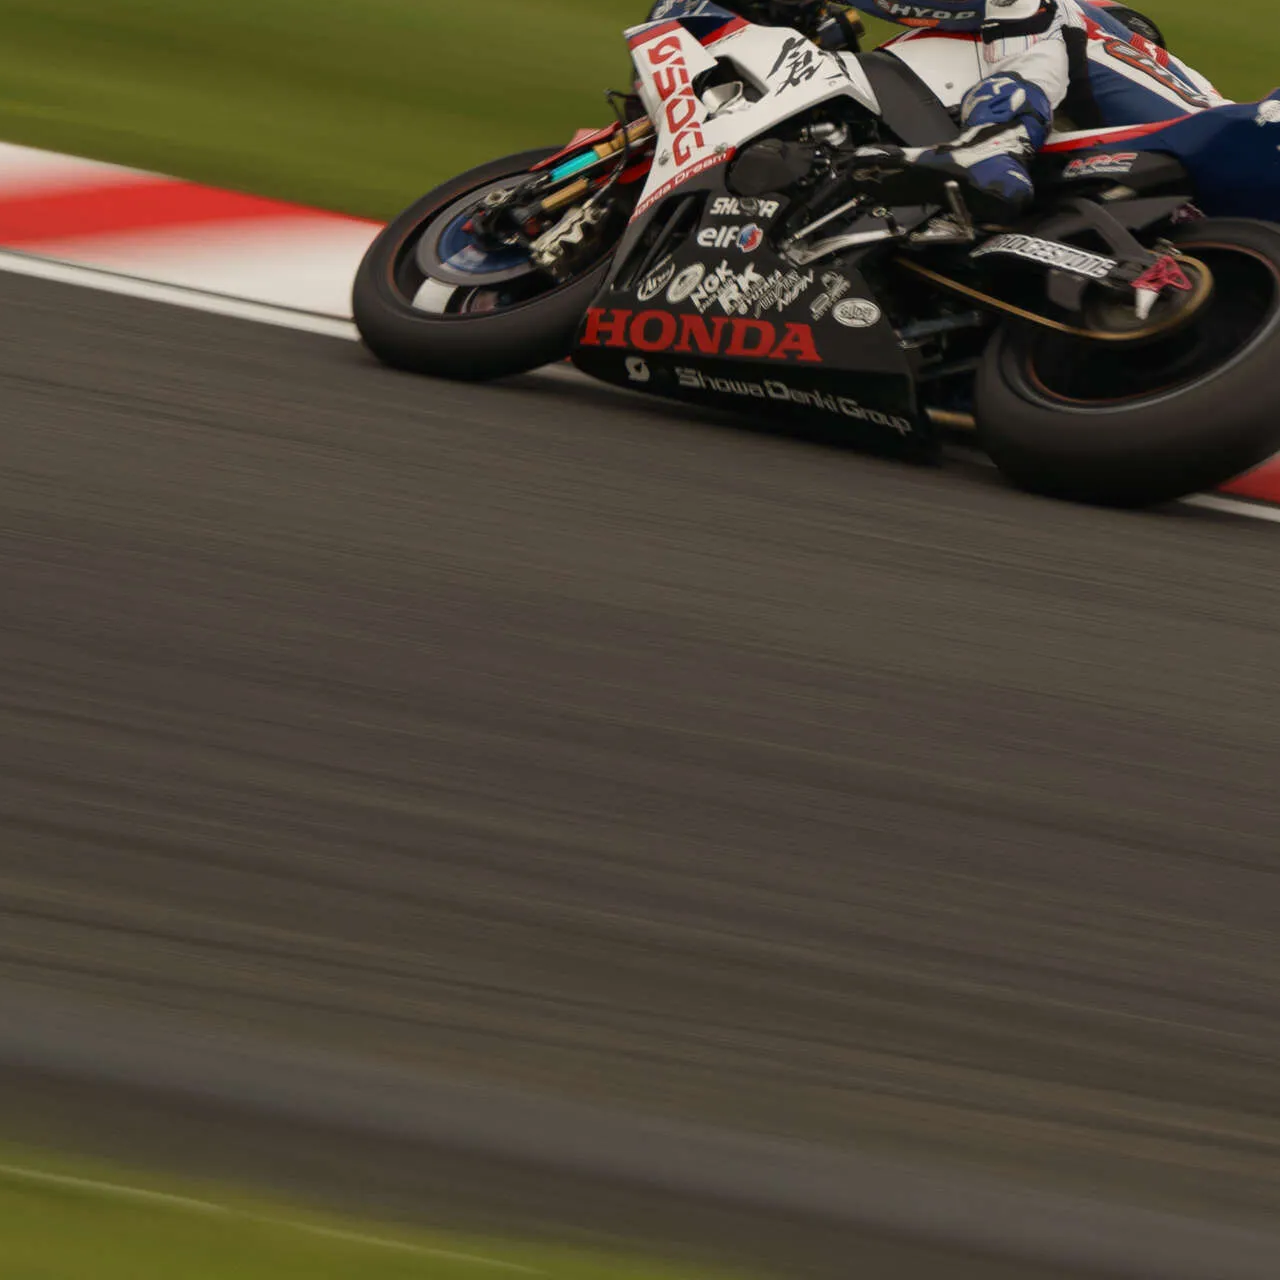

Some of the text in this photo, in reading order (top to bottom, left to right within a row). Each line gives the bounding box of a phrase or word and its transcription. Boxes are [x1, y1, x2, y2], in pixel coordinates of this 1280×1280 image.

[675, 152, 728, 183] Dream
[709, 197, 780, 219] SHA
[696, 224, 739, 249] elf
[580, 307, 823, 362] HONDA
[675, 367, 765, 398] Showa
[838, 397, 913, 436] Group
